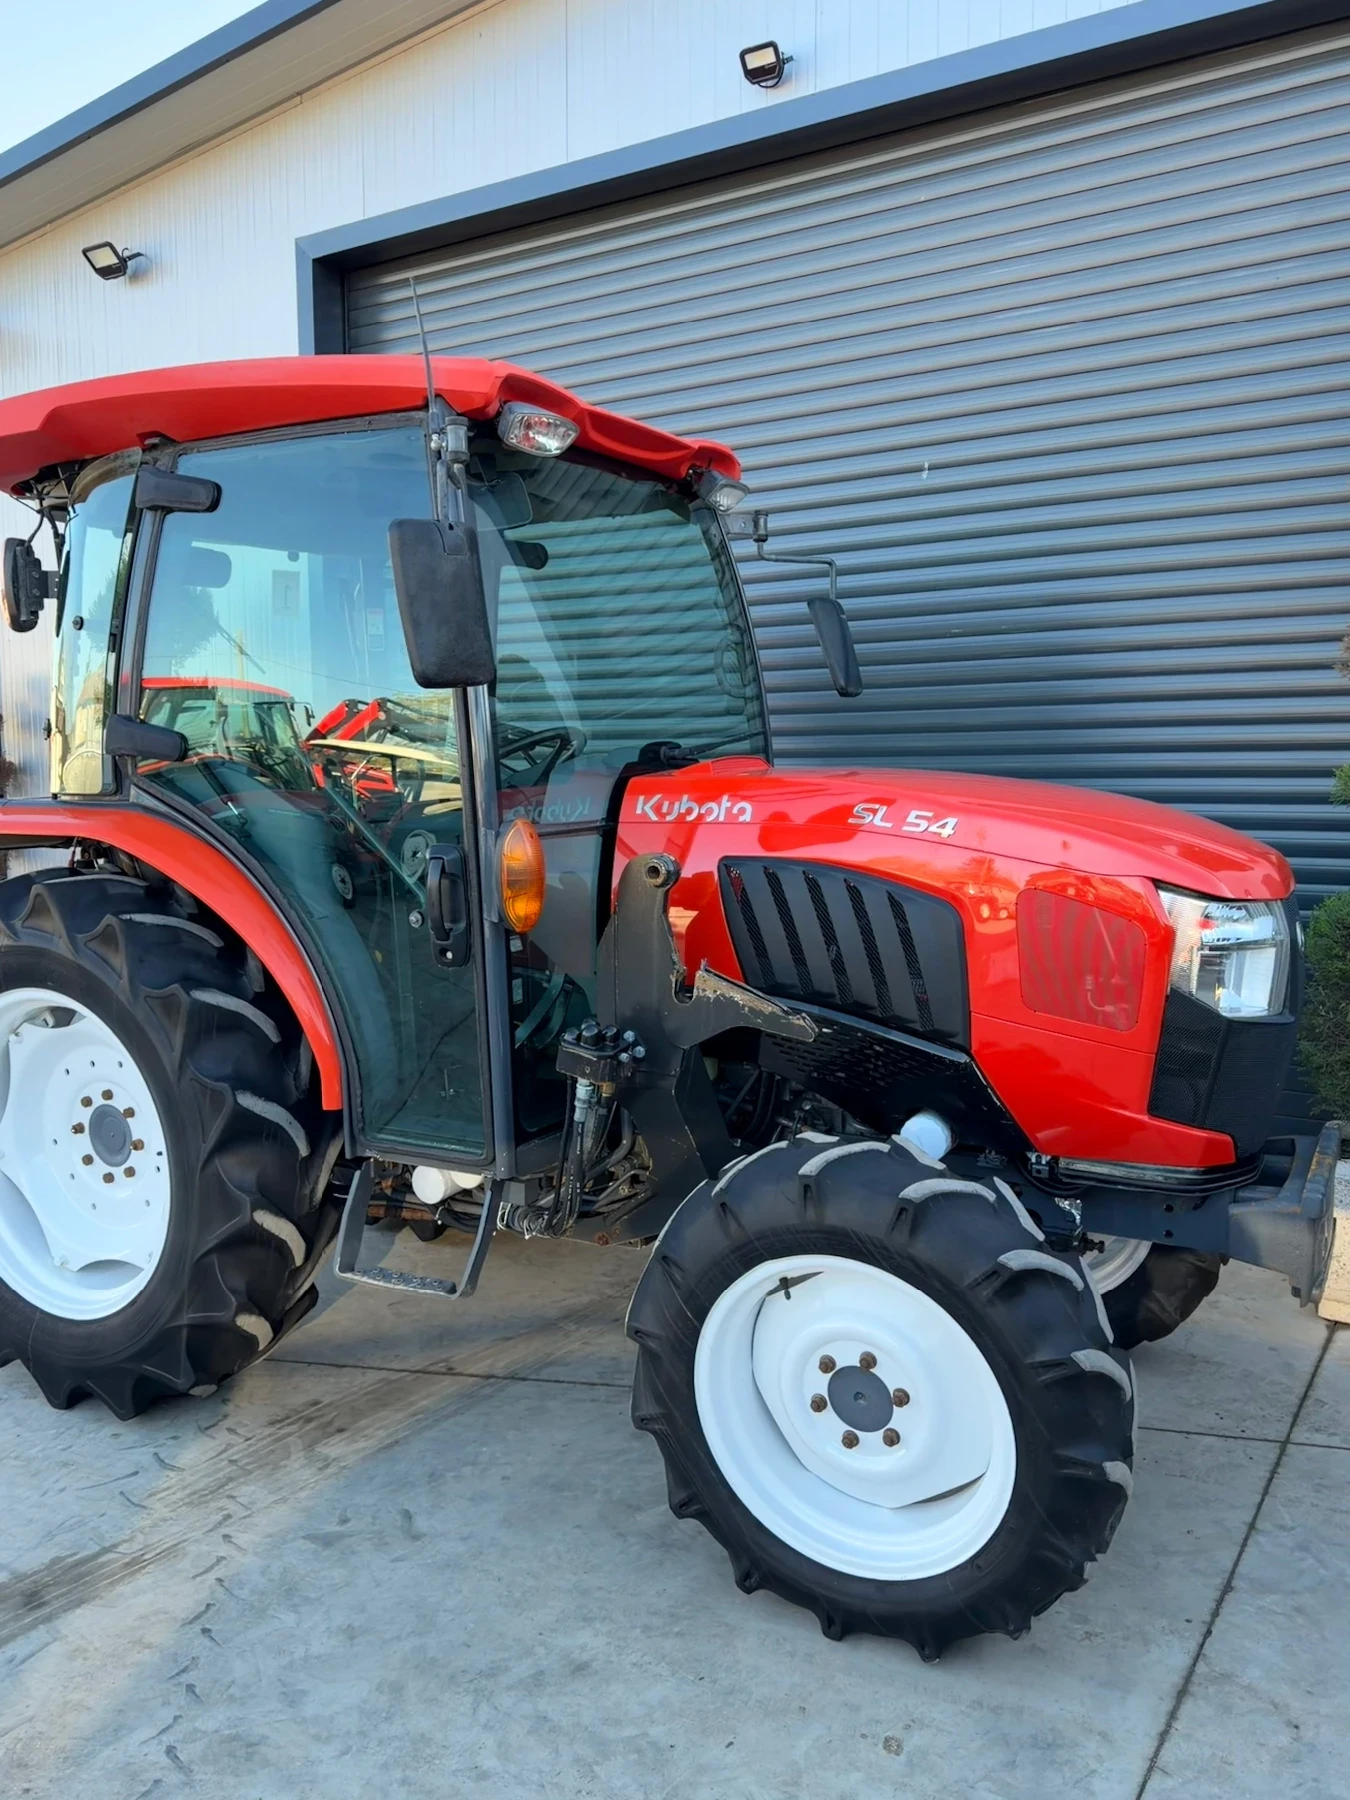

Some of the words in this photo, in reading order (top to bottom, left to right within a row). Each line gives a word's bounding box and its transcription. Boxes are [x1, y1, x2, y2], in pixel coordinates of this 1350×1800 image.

[636, 794, 753, 821] Kubota
[847, 802, 894, 828] SL
[901, 809, 960, 839] 54
